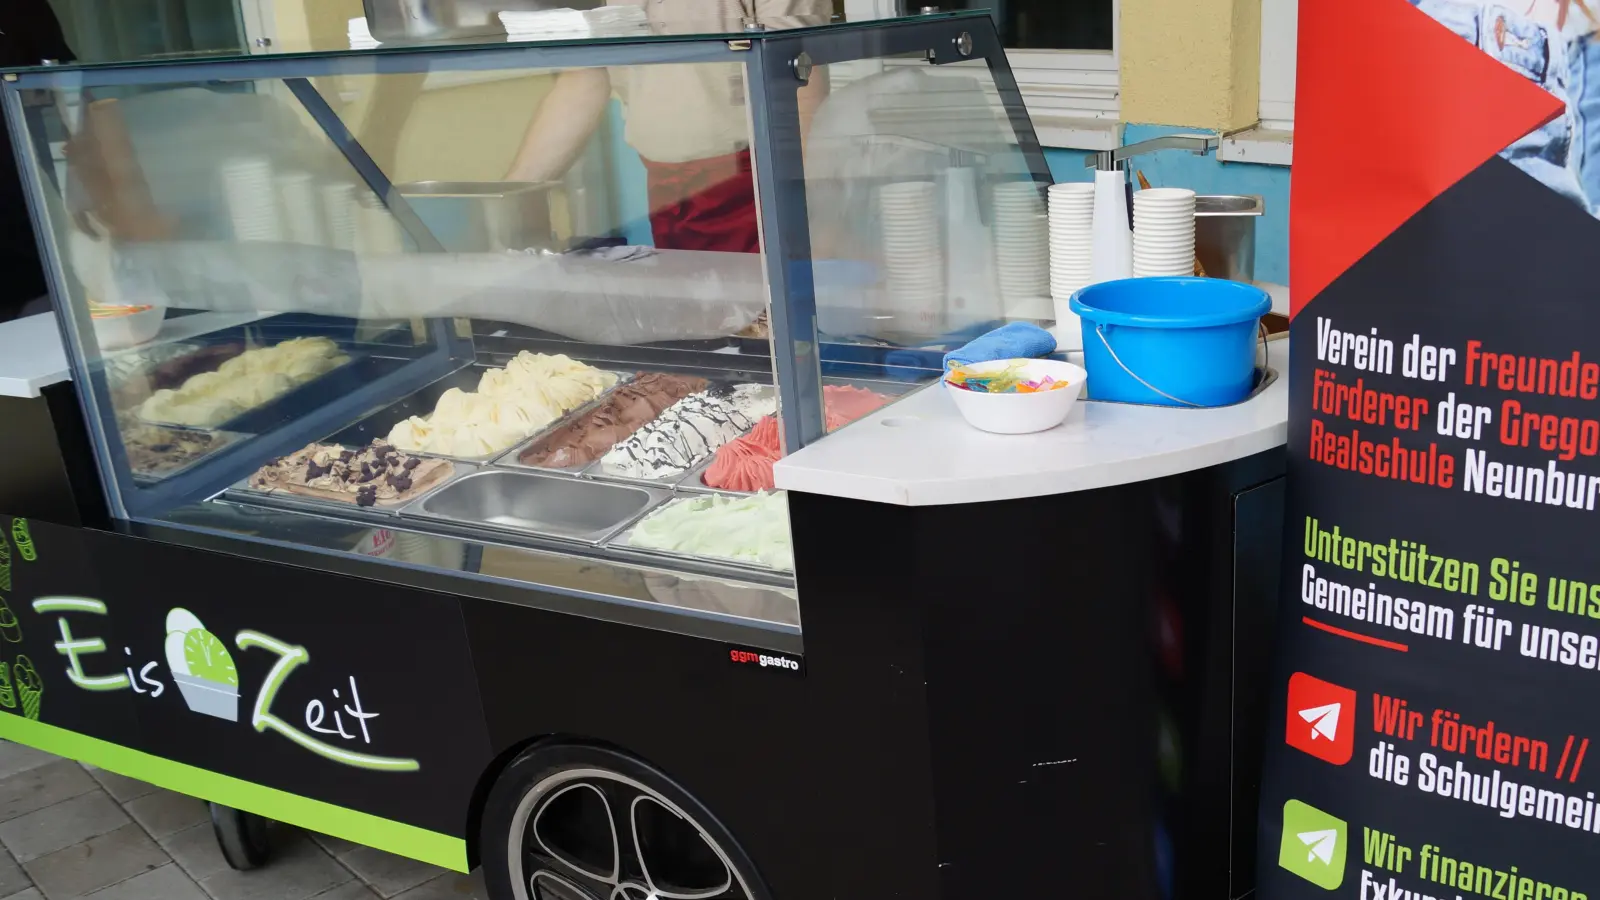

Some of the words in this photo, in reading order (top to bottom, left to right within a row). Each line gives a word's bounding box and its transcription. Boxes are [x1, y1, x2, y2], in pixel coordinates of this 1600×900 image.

[1317, 316, 1394, 375] Verein
[1402, 334, 1456, 382] der
[1465, 340, 1600, 400] Freunde
[1312, 368, 1428, 431] Förderer
[1437, 392, 1492, 440] der
[1309, 419, 1454, 488] Realschule
[1304, 516, 1479, 595] Unterstützen
[1488, 557, 1538, 606] Sie
[1301, 563, 1454, 640] Gemeinsam
[1463, 604, 1512, 650] für
[1520, 623, 1600, 671] unse
[32, 596, 164, 698] Eis
[235, 630, 420, 771] Zeit
[1369, 741, 1410, 786] die
[1373, 693, 1423, 740] Wir
[1431, 708, 1548, 772] fördern
[1363, 826, 1412, 873] Wir
